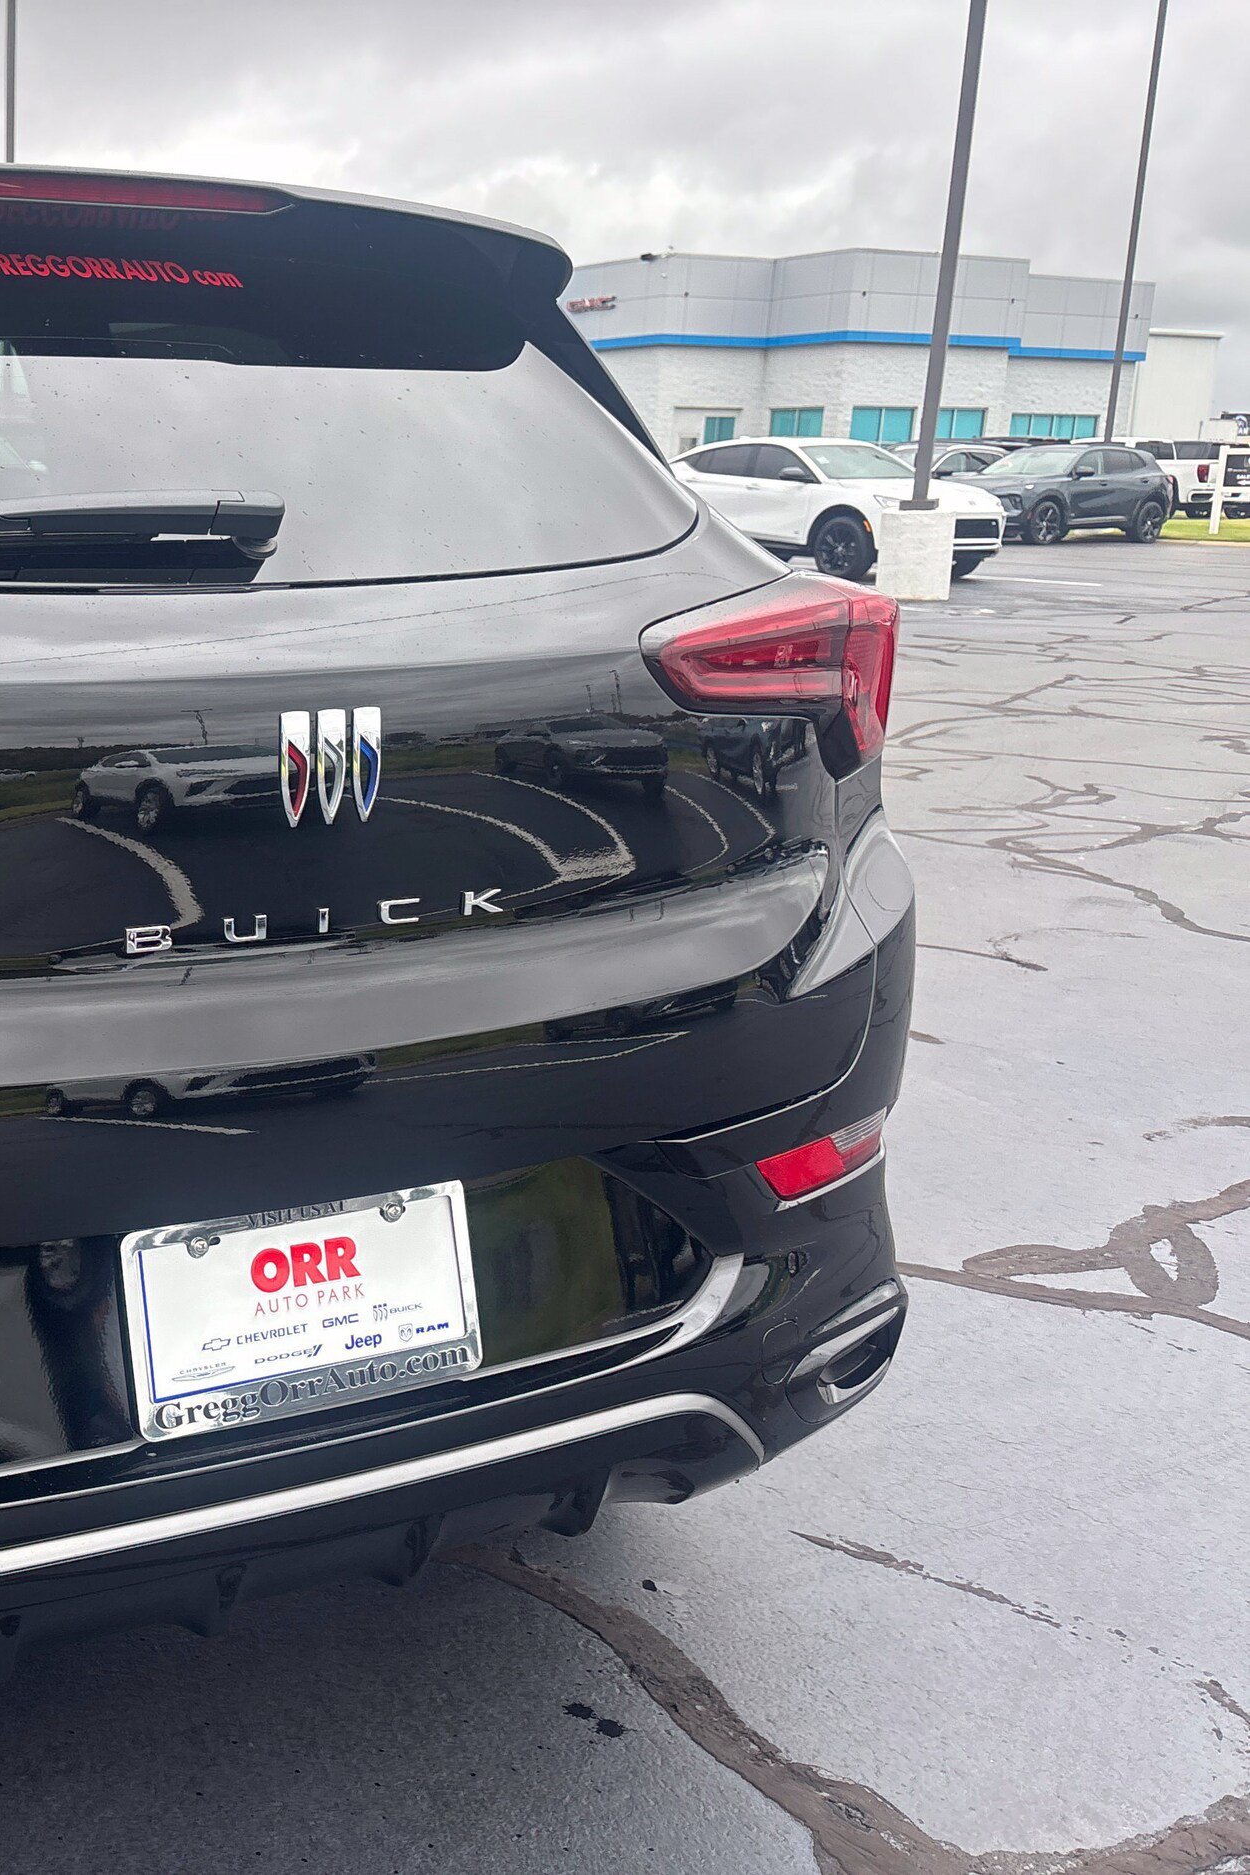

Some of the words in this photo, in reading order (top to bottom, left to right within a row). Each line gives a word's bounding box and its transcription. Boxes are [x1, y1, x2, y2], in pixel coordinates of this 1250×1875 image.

[124, 888, 504, 955] BUICK
[250, 1236, 361, 1293] ORR
[254, 1293, 308, 1316] AUTO
[317, 1283, 365, 1305] PARK
[389, 1302, 423, 1314] BUICK
[322, 1313, 359, 1328] GMC
[415, 1322, 449, 1334] RAM
[236, 1323, 308, 1345] CHEVROLET
[345, 1333, 382, 1350] Jeep
[254, 1347, 312, 1364] DODGE
[154, 1344, 470, 1432] GreggOrrAuto.com
